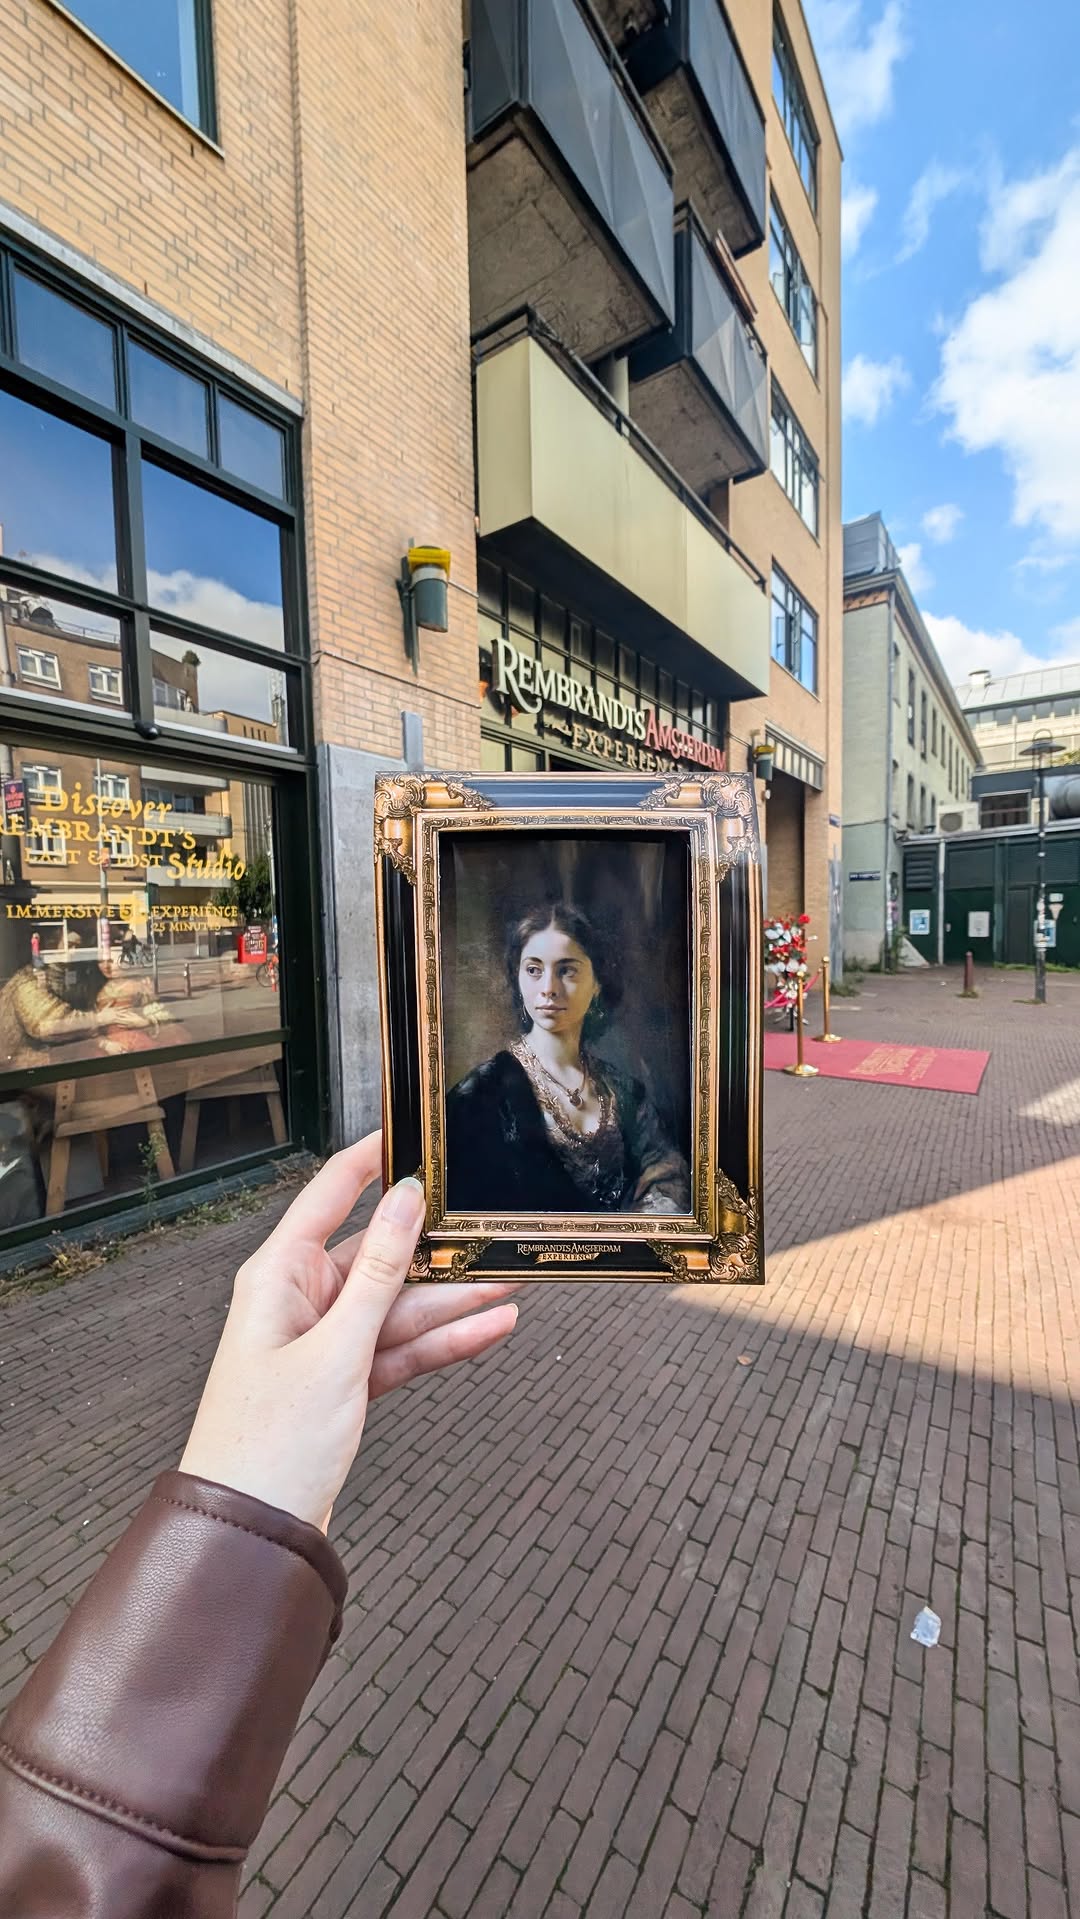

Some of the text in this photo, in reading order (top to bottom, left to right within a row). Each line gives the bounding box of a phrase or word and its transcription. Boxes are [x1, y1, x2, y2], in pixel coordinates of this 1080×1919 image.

[36, 782, 172, 823] Discover
[24, 847, 81, 865] LAT
[166, 848, 247, 880] Studio
[6, 904, 116, 919] IMMERSIVE
[152, 905, 238, 918] EXPERIENCE
[571, 1243, 621, 1253] AMSTERDAM
[542, 1253, 595, 1261] EXPERIENCE
